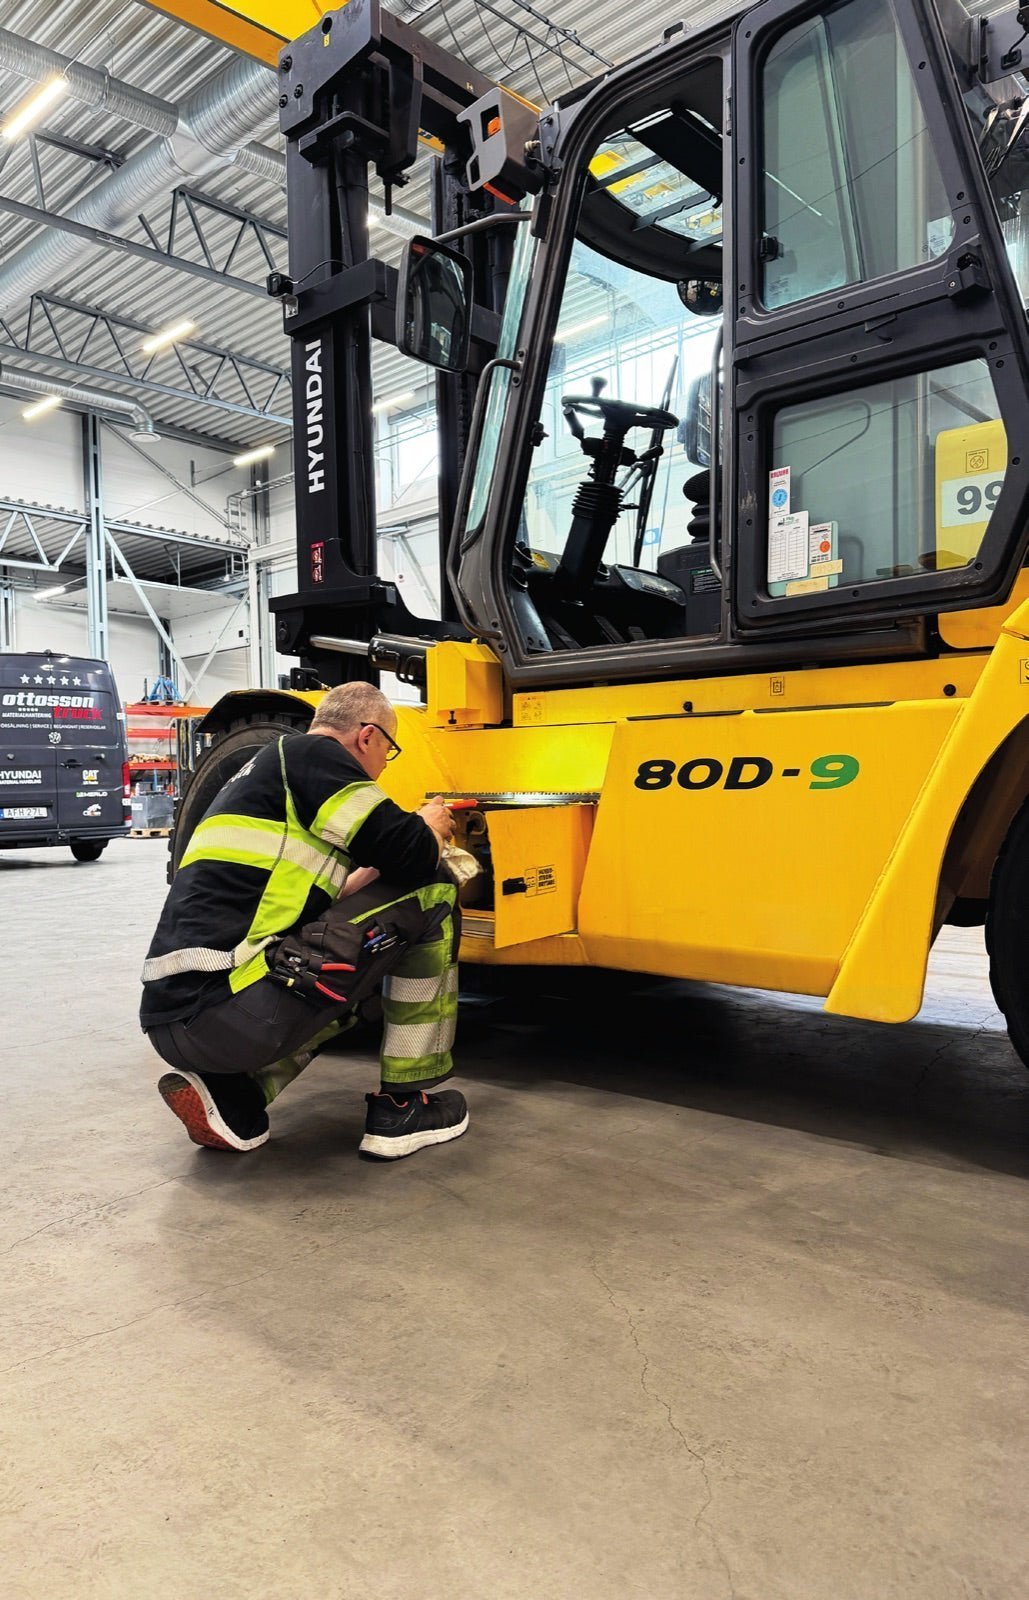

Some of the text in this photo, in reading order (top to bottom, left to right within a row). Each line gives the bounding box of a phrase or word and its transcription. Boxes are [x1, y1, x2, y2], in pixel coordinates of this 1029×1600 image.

[305, 339, 325, 493] HYUNDAI
[2, 692, 95, 708] ottosson
[53, 706, 103, 720] truck
[0, 770, 42, 779] HYUNDAI
[82, 769, 99, 780] CAT
